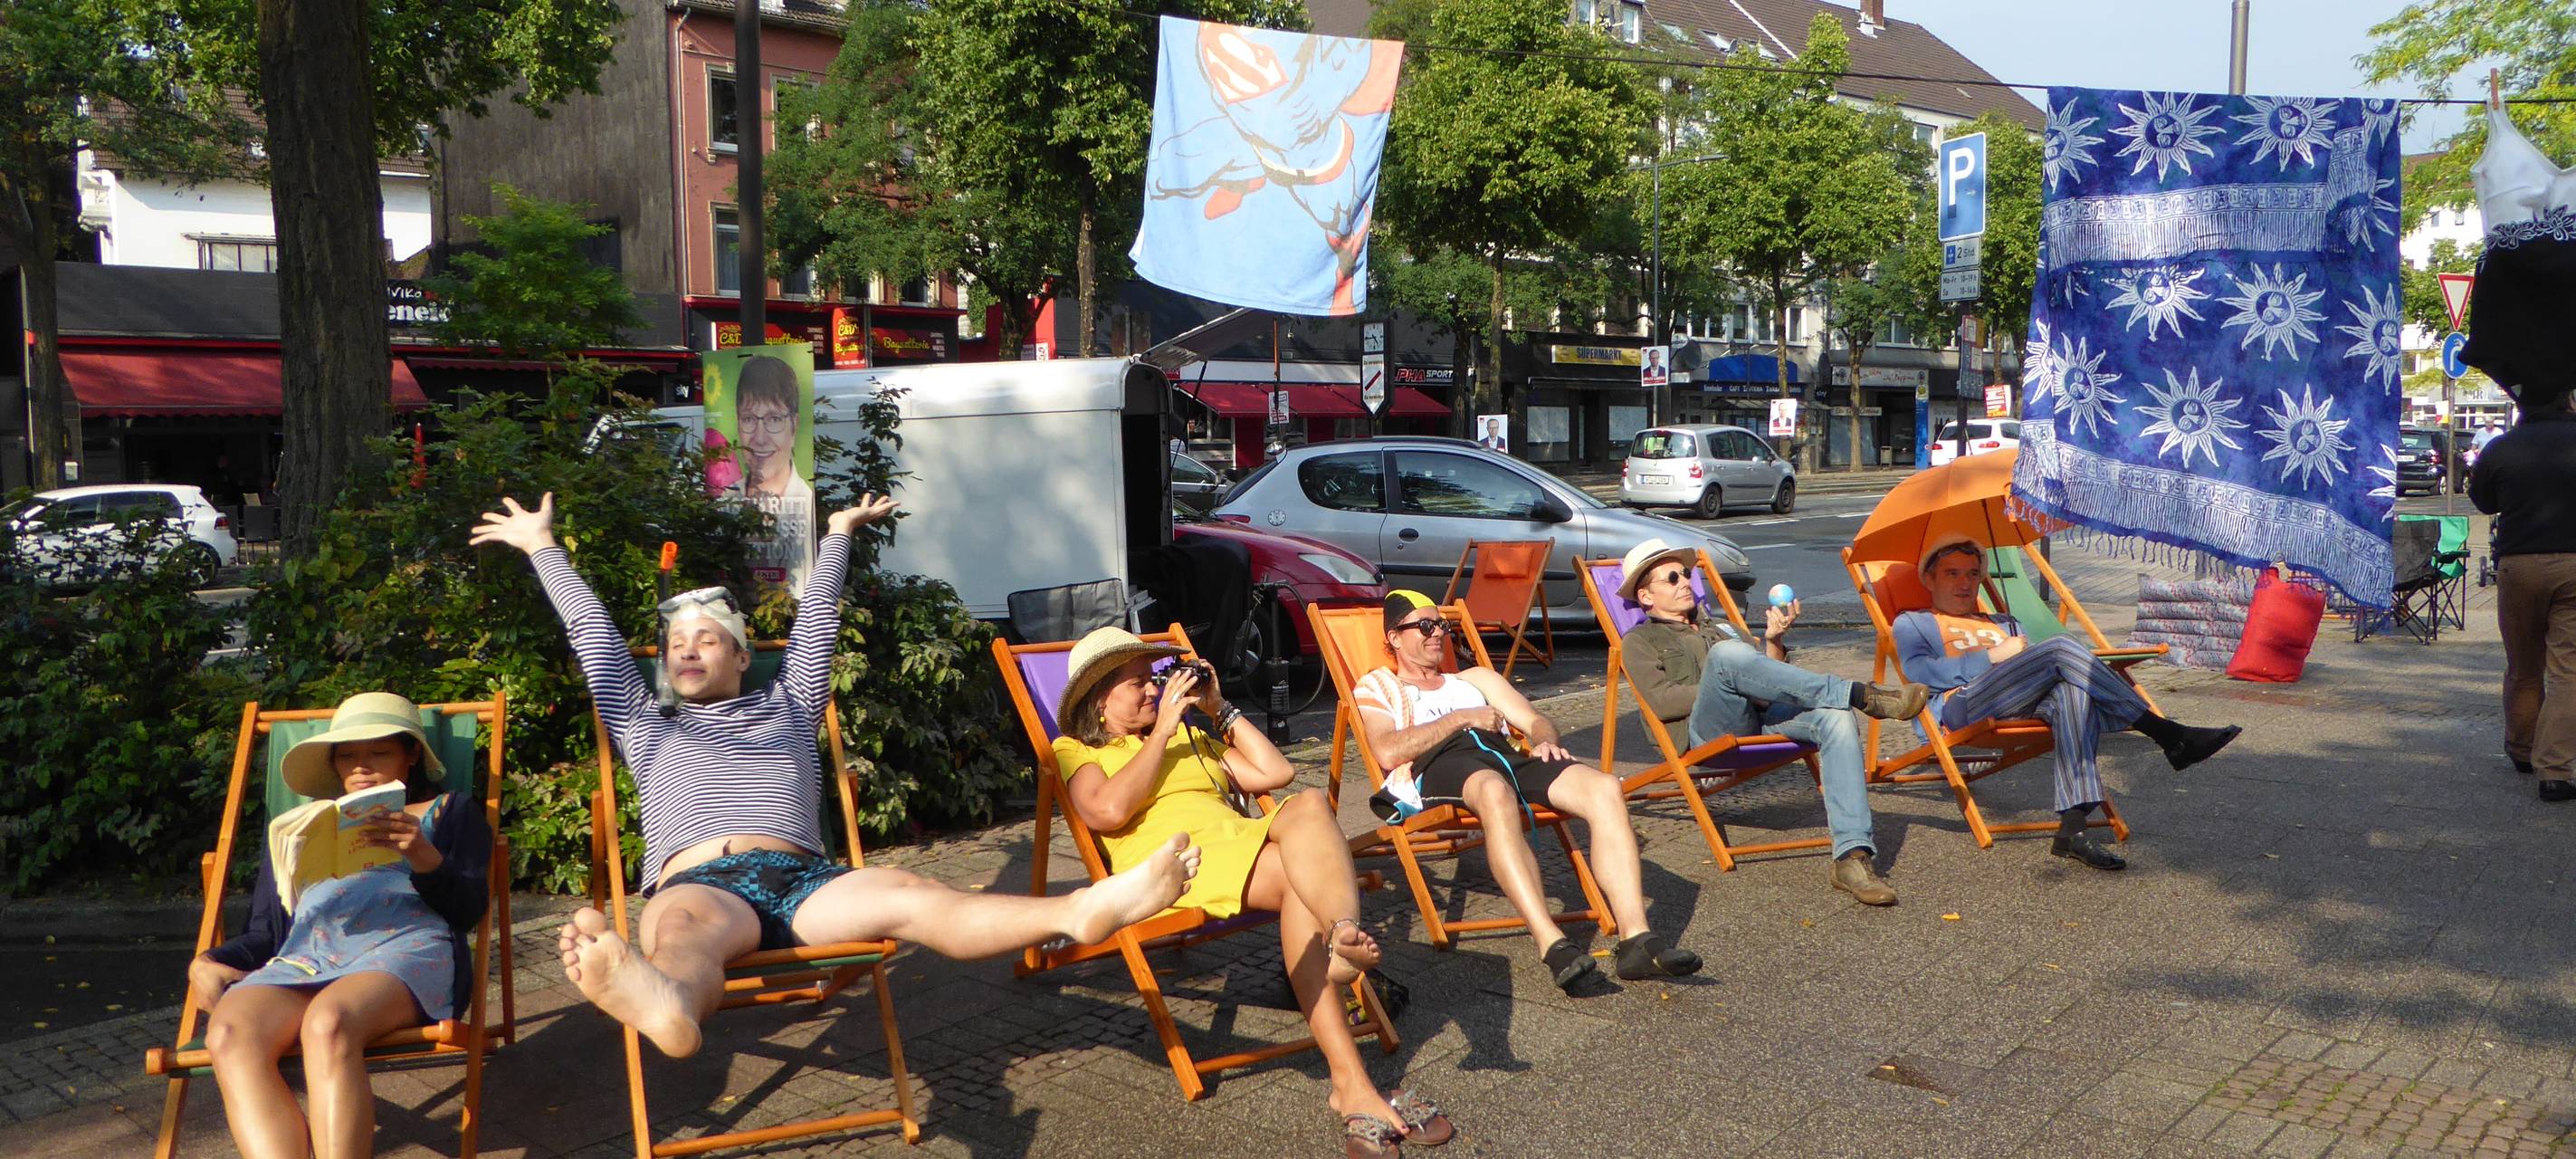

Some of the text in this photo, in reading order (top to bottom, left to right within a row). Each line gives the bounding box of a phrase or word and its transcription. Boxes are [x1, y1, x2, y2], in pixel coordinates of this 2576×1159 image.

[1949, 147, 1976, 206] P
[1957, 246, 1963, 259] 2
[1576, 347, 1622, 360] SUPERMARKT
[1426, 369, 1454, 378] SPORT
